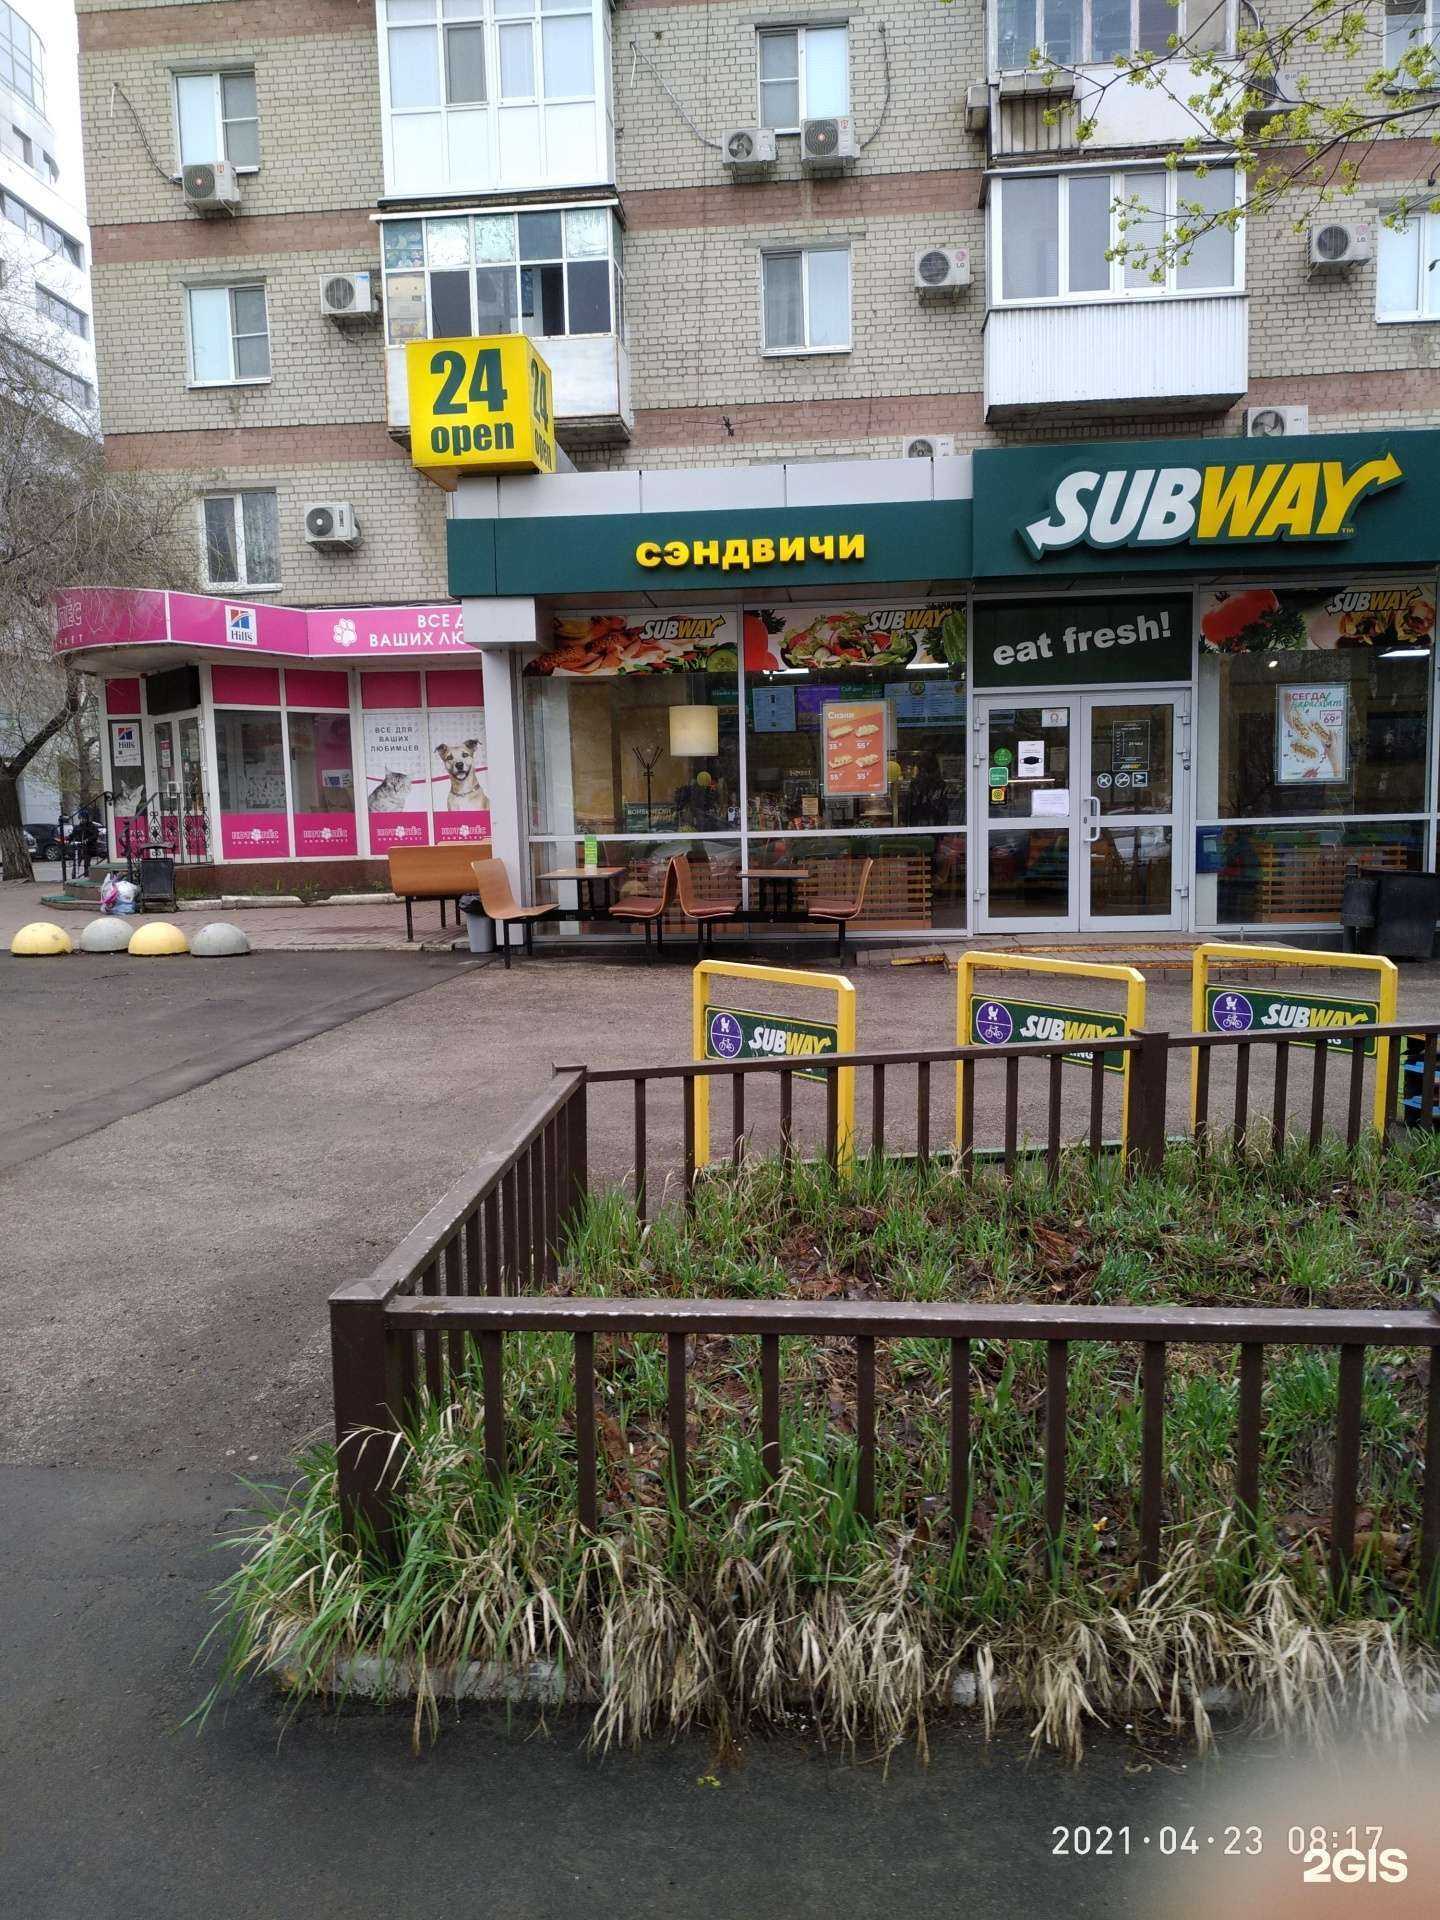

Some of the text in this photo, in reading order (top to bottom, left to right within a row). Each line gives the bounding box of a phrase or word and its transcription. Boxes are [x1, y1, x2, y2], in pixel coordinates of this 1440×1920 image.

[430, 348, 508, 415] 24
[530, 357, 549, 433] 24
[430, 421, 515, 456] open
[1026, 452, 1402, 551] SUBWAY
[1325, 587, 1422, 615] SUBWAY
[417, 614, 450, 629] ВСЕ
[639, 615, 726, 642] SUBWAY
[864, 608, 952, 631] SUBWAY
[369, 632, 434, 648] ВАШИХ
[992, 611, 1172, 666] eat fresh!
[1019, 1014, 1118, 1041] SUBWAY
[1261, 1003, 1369, 1027] SUBWAY
[748, 1026, 832, 1056] SUBWAY
